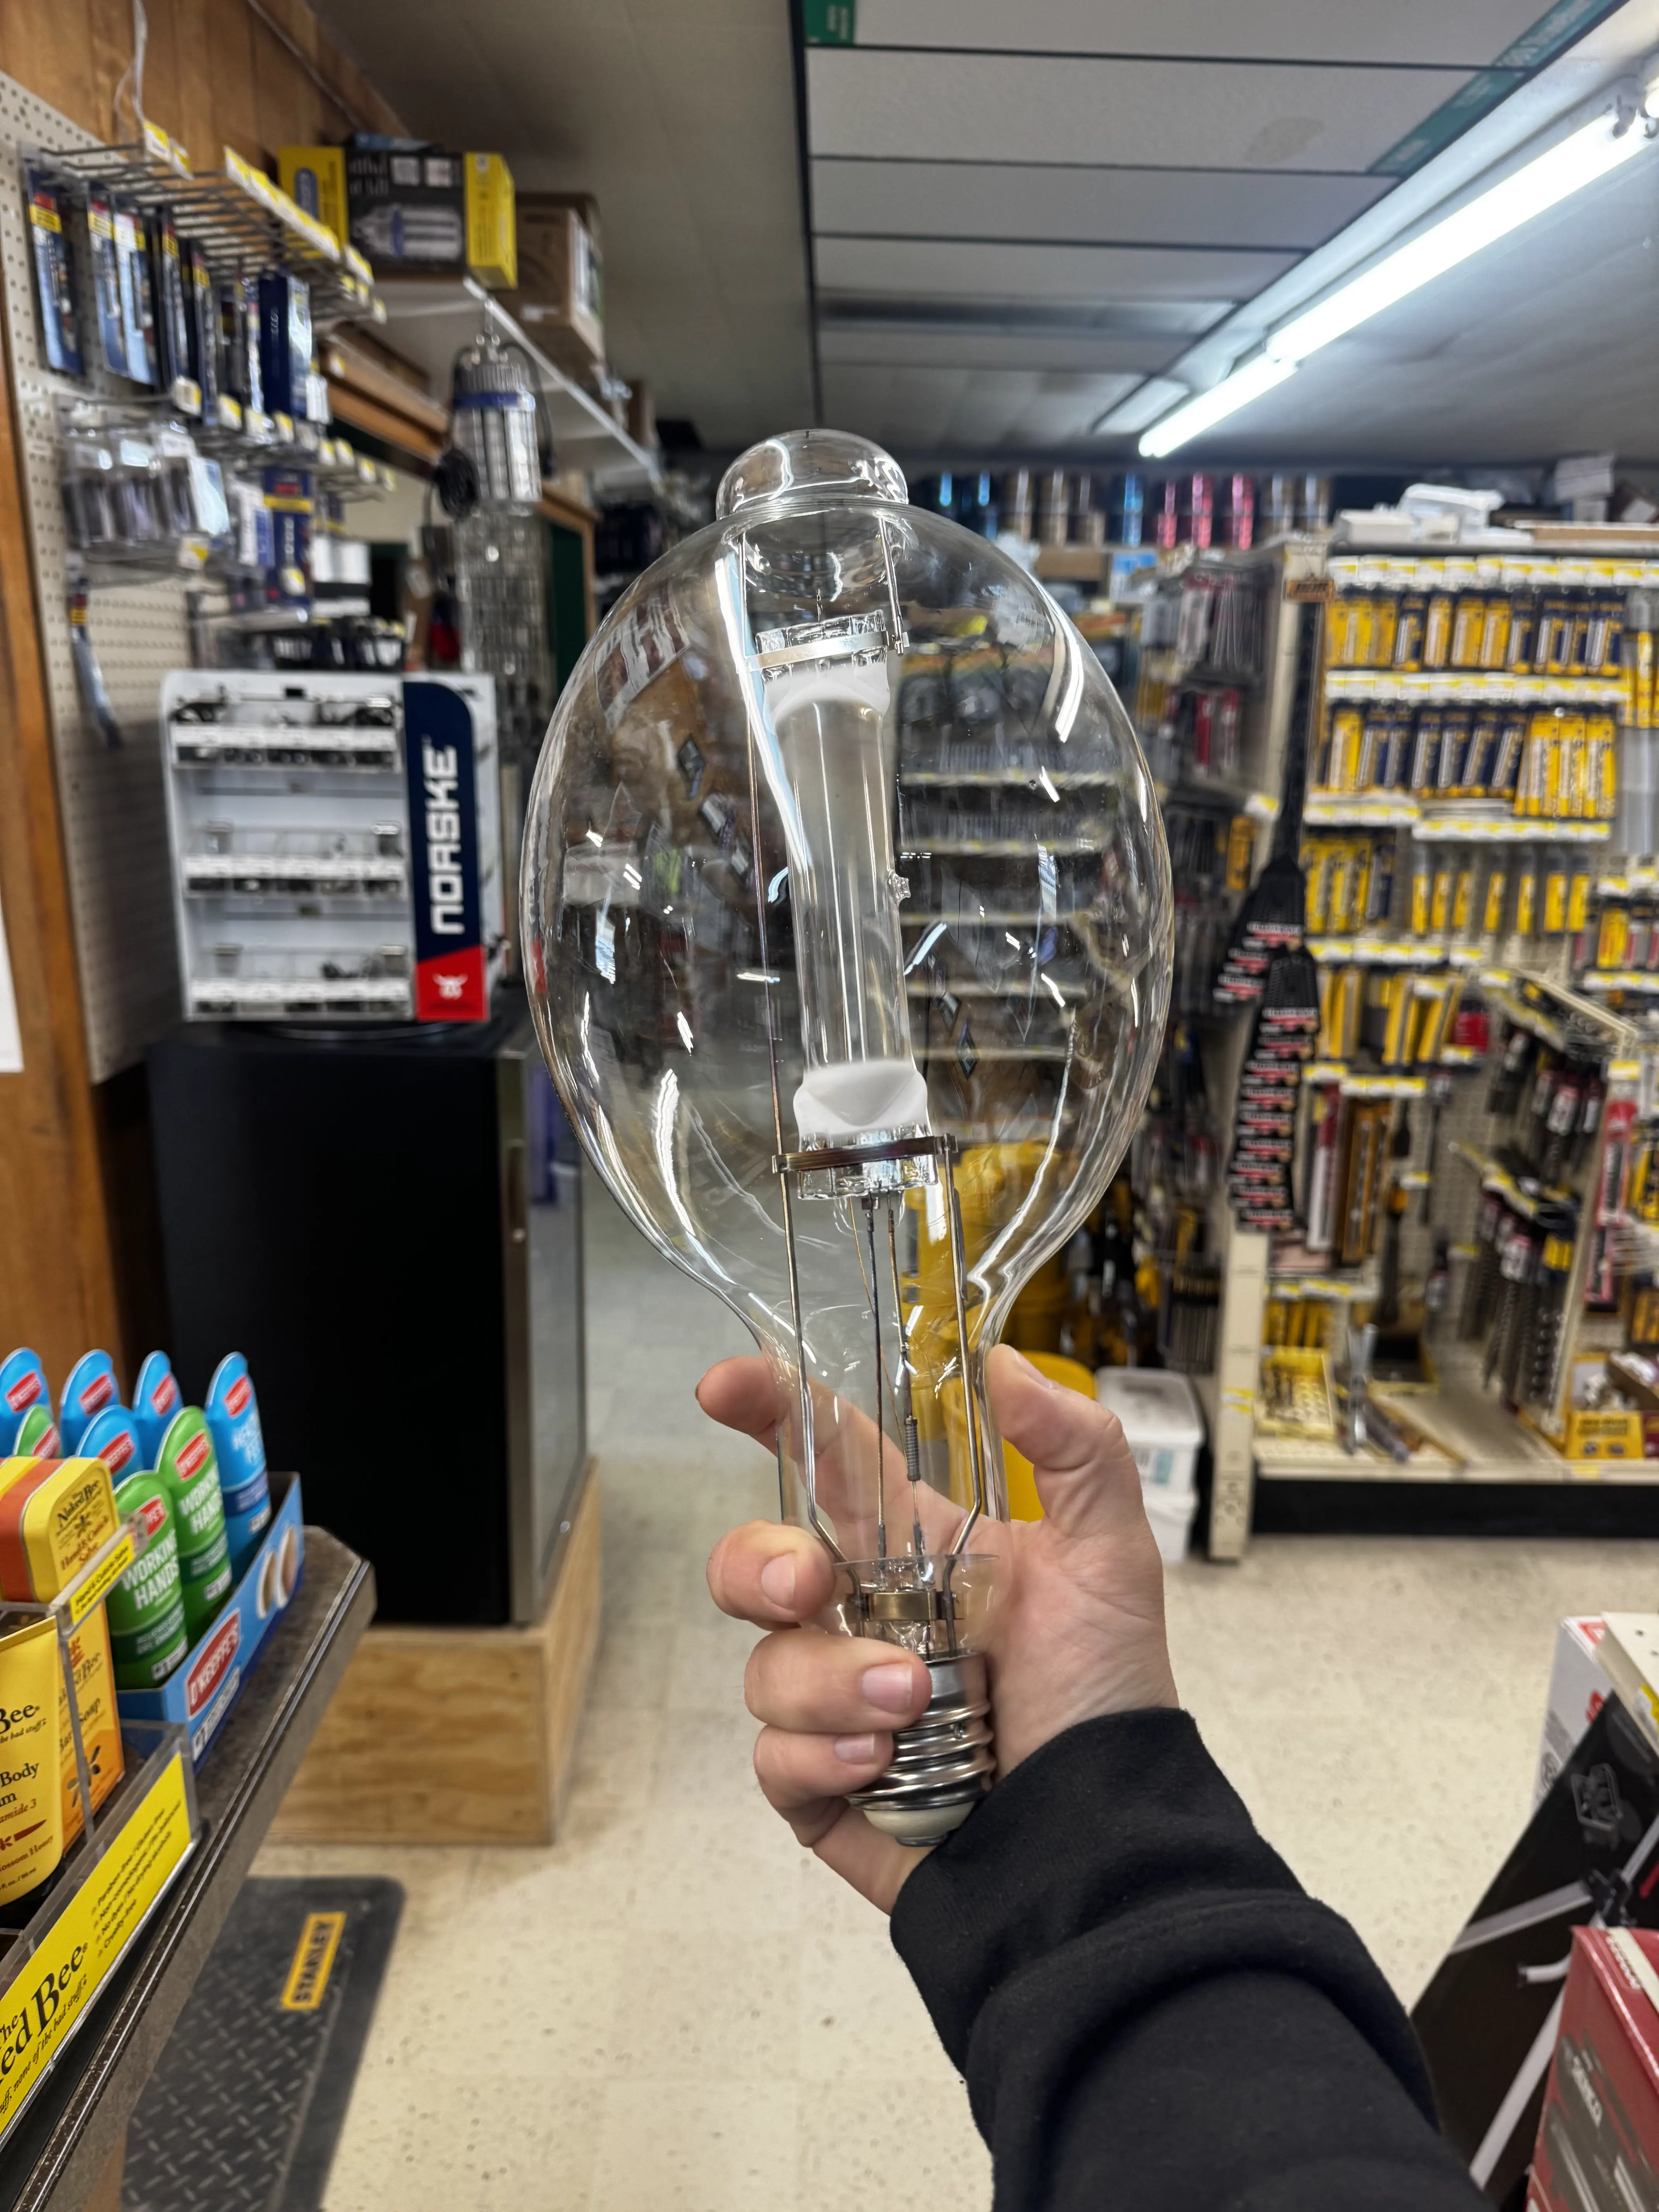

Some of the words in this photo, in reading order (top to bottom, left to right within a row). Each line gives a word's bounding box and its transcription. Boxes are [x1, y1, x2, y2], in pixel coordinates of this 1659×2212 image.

[423, 745, 465, 935] NORSKE
[0, 1763, 39, 1788] Body
[30, 1798, 36, 1809] 3
[293, 1922, 335, 2002] STANLEY
[14, 2062, 31, 2092] none
[33, 2042, 41, 2064] of
[41, 2030, 52, 2050] the
[53, 2004, 66, 2032] bad
